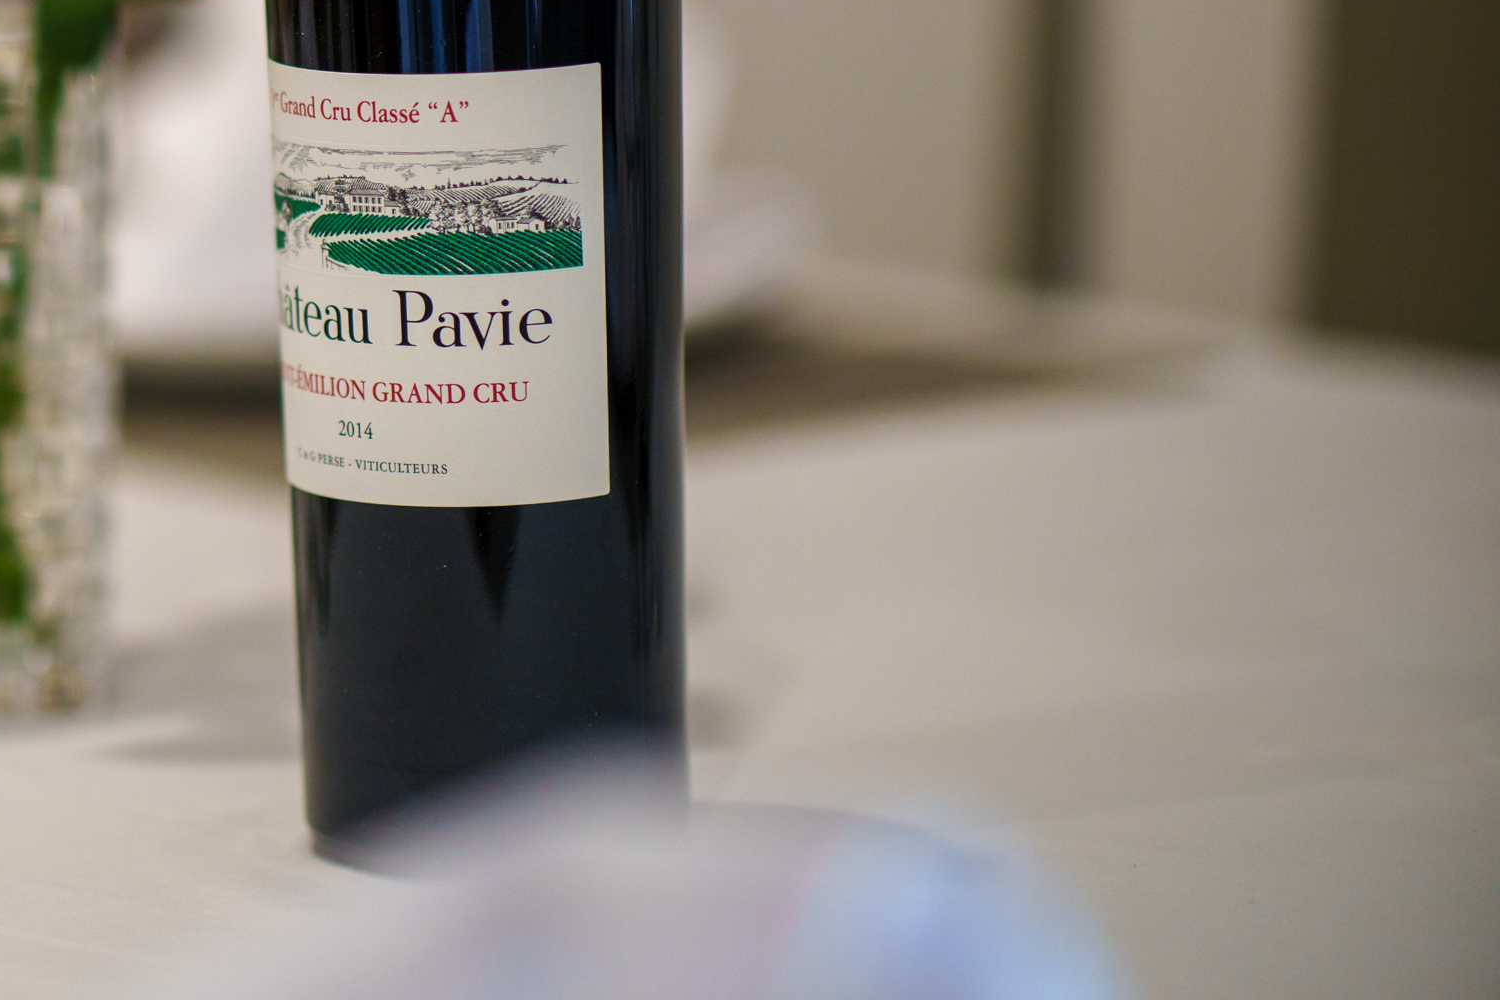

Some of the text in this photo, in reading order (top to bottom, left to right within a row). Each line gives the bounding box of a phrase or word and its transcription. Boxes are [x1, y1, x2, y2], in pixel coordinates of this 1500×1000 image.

[279, 91, 316, 119] Grand
[320, 98, 352, 122] Cru
[357, 101, 420, 124] Classé
[279, 284, 553, 351] âteau Pavie
[372, 381, 466, 405] GRAND
[473, 380, 529, 404] CRU
[338, 420, 373, 439] 2014
[317, 452, 345, 468] PERSE
[355, 459, 448, 475] VITICULTEURS
